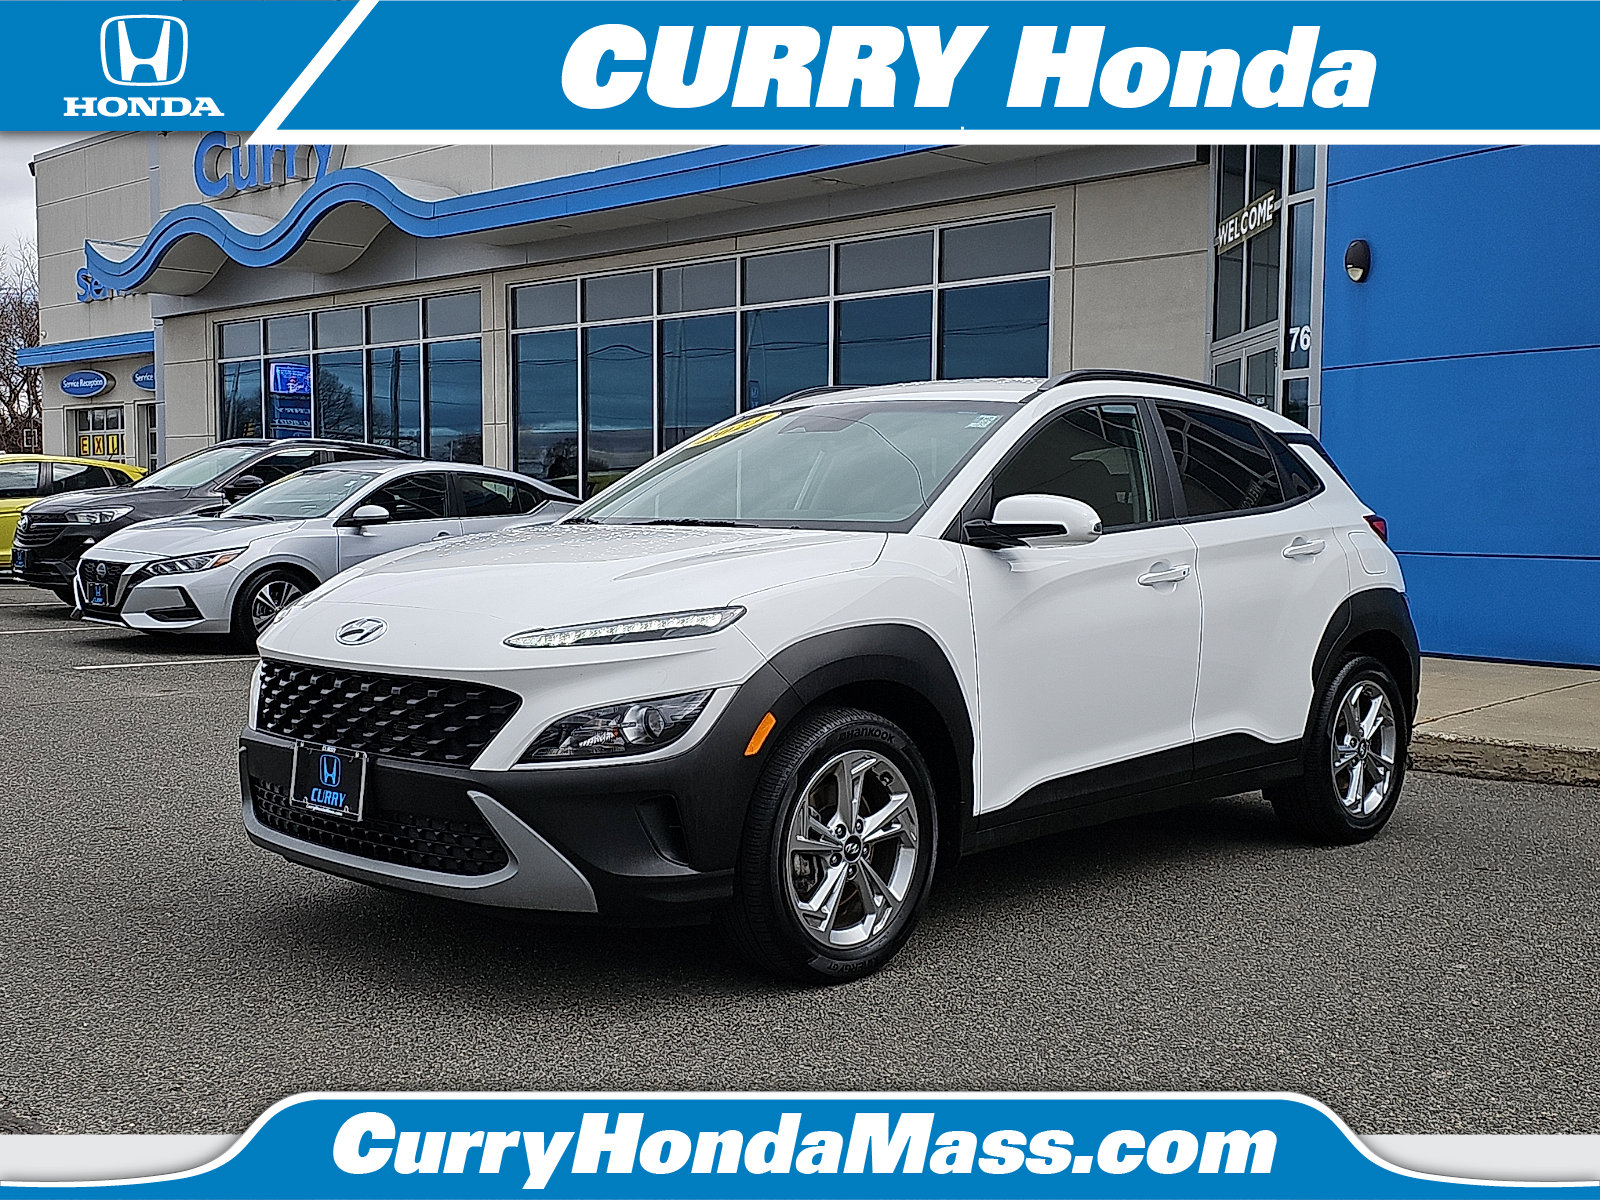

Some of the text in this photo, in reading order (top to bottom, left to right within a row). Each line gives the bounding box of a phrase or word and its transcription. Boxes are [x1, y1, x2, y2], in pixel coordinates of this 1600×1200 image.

[1218, 196, 1274, 247] WELCOME
[1289, 325, 1311, 352] 76
[63, 377, 103, 389] Service Reception
[135, 373, 153, 383] Service
[81, 437, 118, 454] EXI
[310, 787, 347, 808] CURRY
